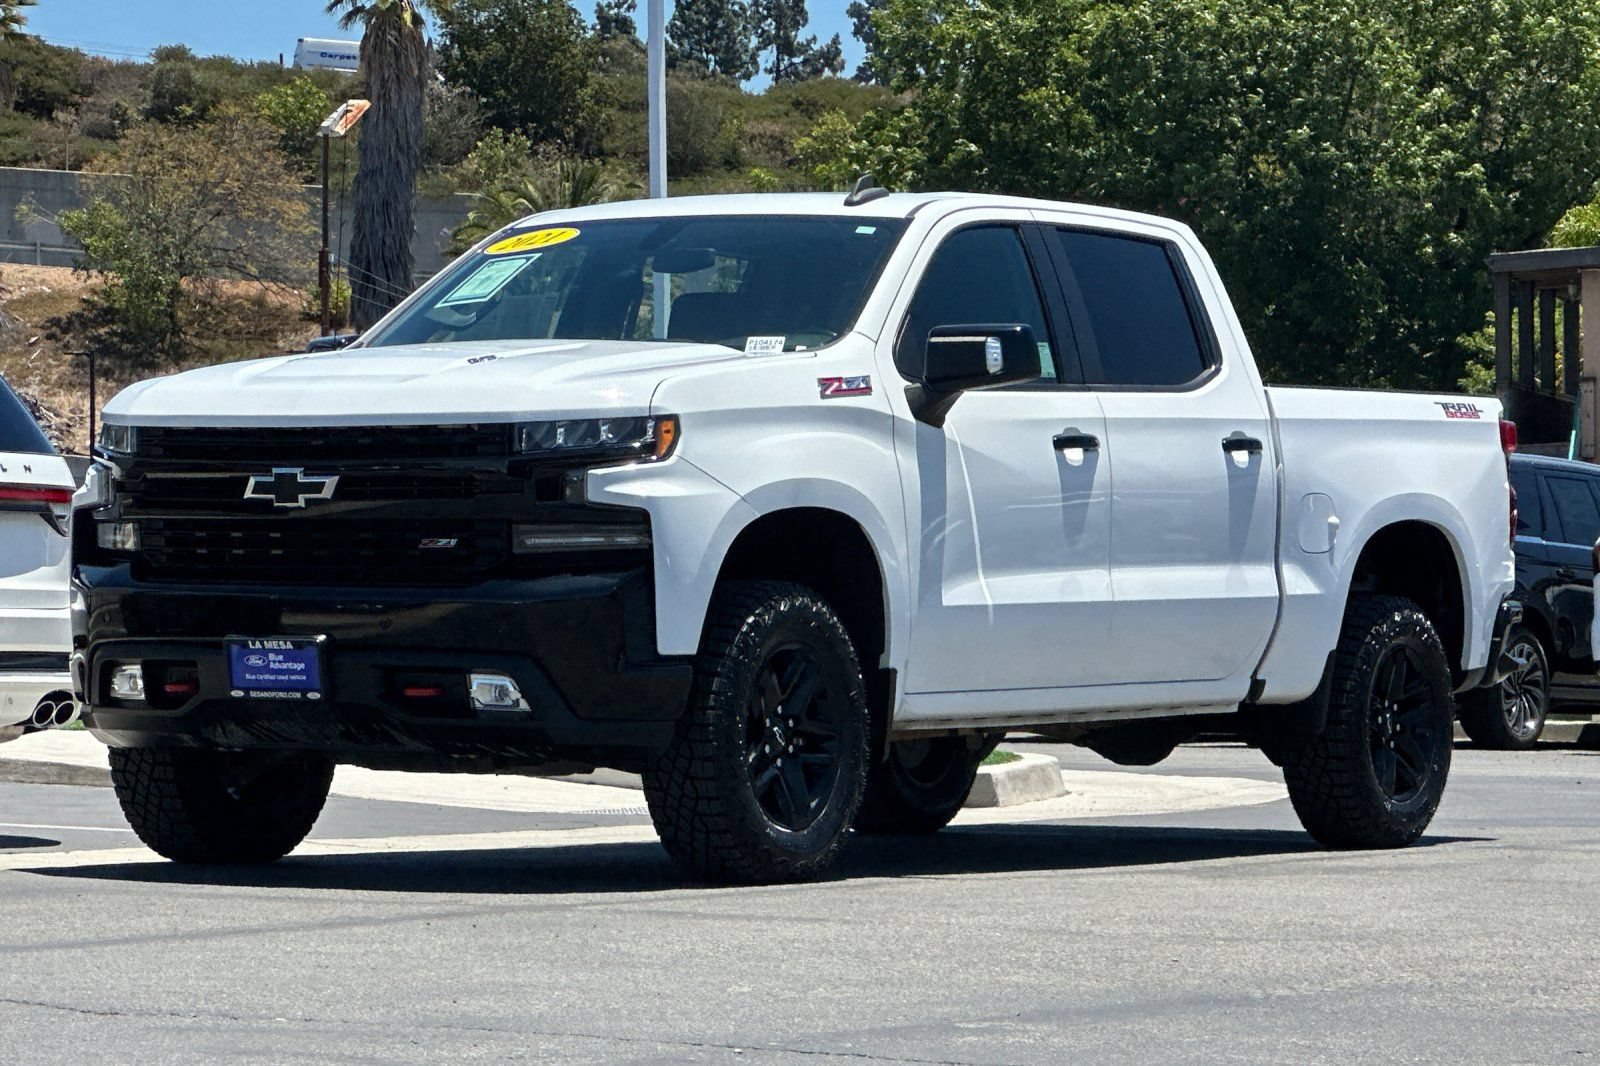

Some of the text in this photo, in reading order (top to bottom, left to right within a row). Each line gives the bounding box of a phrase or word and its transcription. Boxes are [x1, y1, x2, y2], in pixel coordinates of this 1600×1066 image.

[497, 230, 569, 251] 2021
[1434, 402, 1483, 412] TRAIL
[1445, 411, 1480, 419] BOSS
[248, 640, 294, 650] LA MESA
[268, 653, 284, 661] Blue
[269, 661, 306, 671] Advantage
